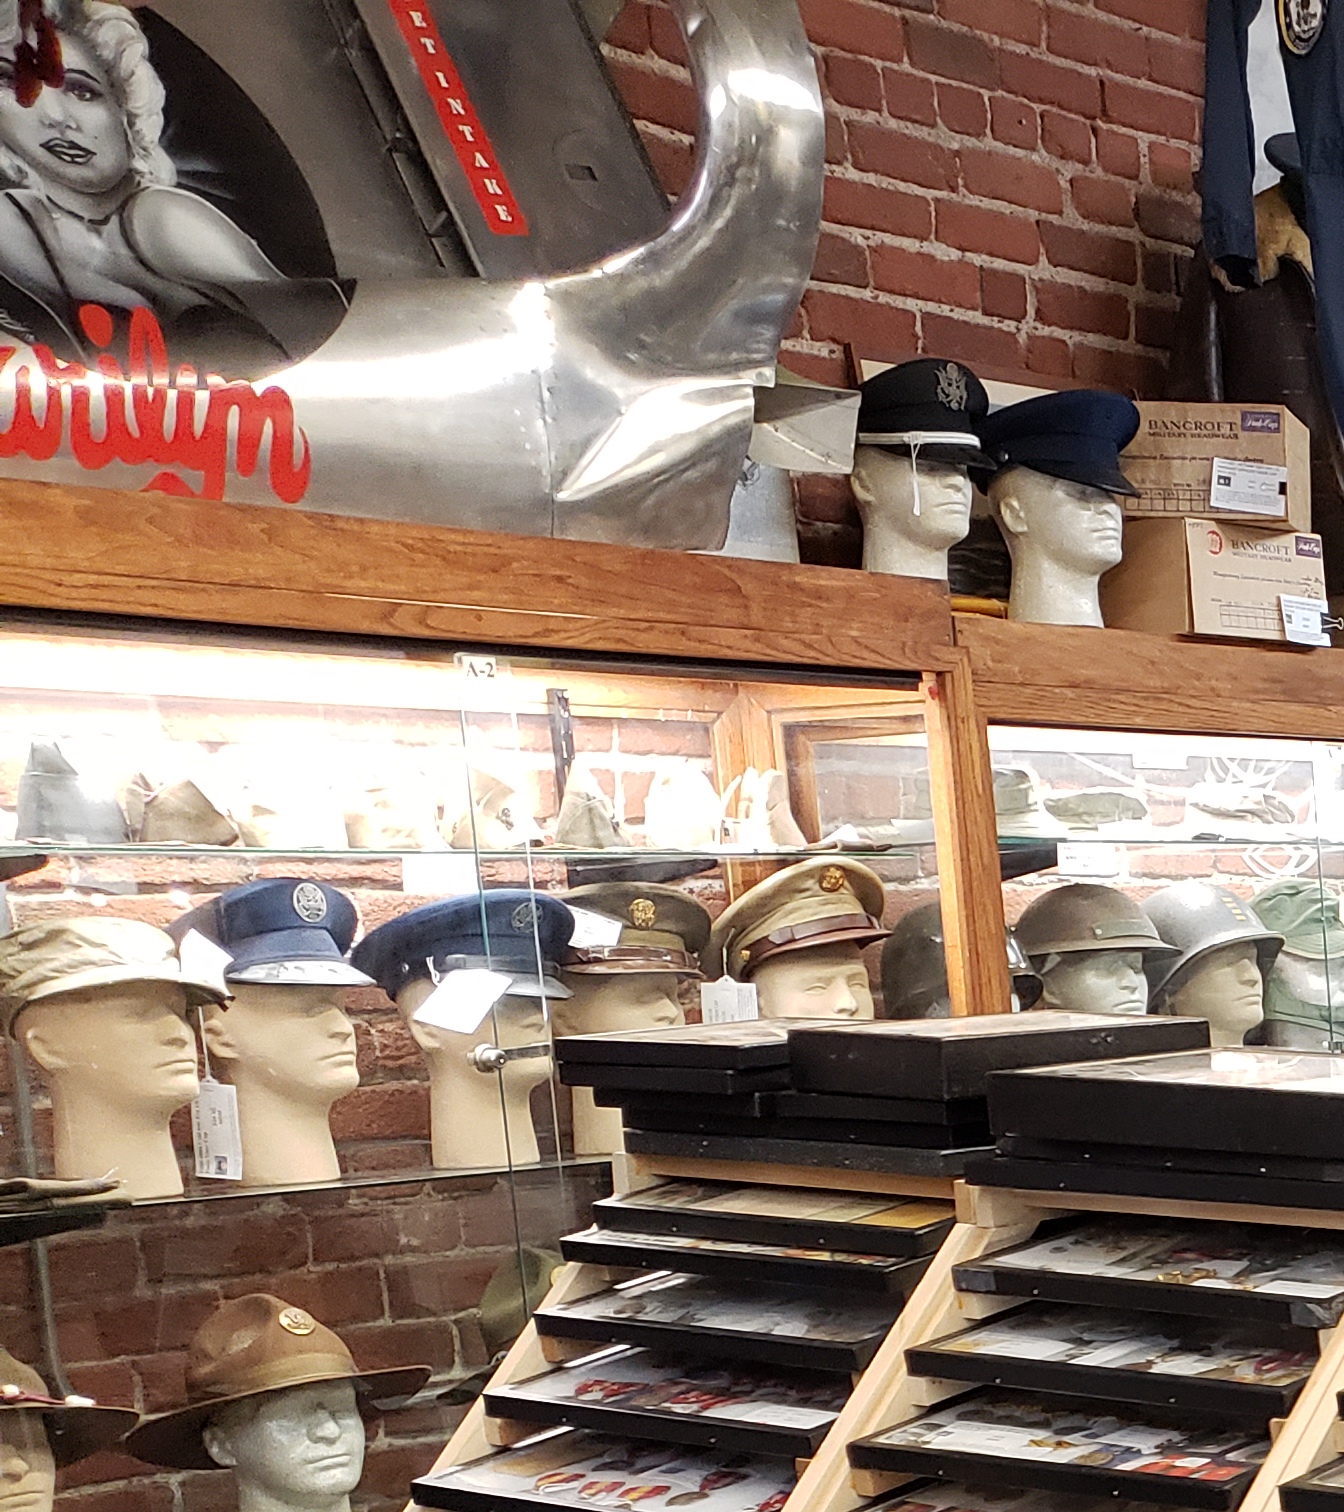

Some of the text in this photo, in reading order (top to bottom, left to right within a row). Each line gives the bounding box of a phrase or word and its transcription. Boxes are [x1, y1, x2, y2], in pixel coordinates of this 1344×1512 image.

[404, 0, 513, 222] ET INTAKE
[1148, 419, 1237, 432] BANCROFT
[1147, 431, 1240, 440] MILITARY HEADWEAR
[1231, 539, 1291, 556] BANCROFT
[466, 661, 495, 678] A-2
